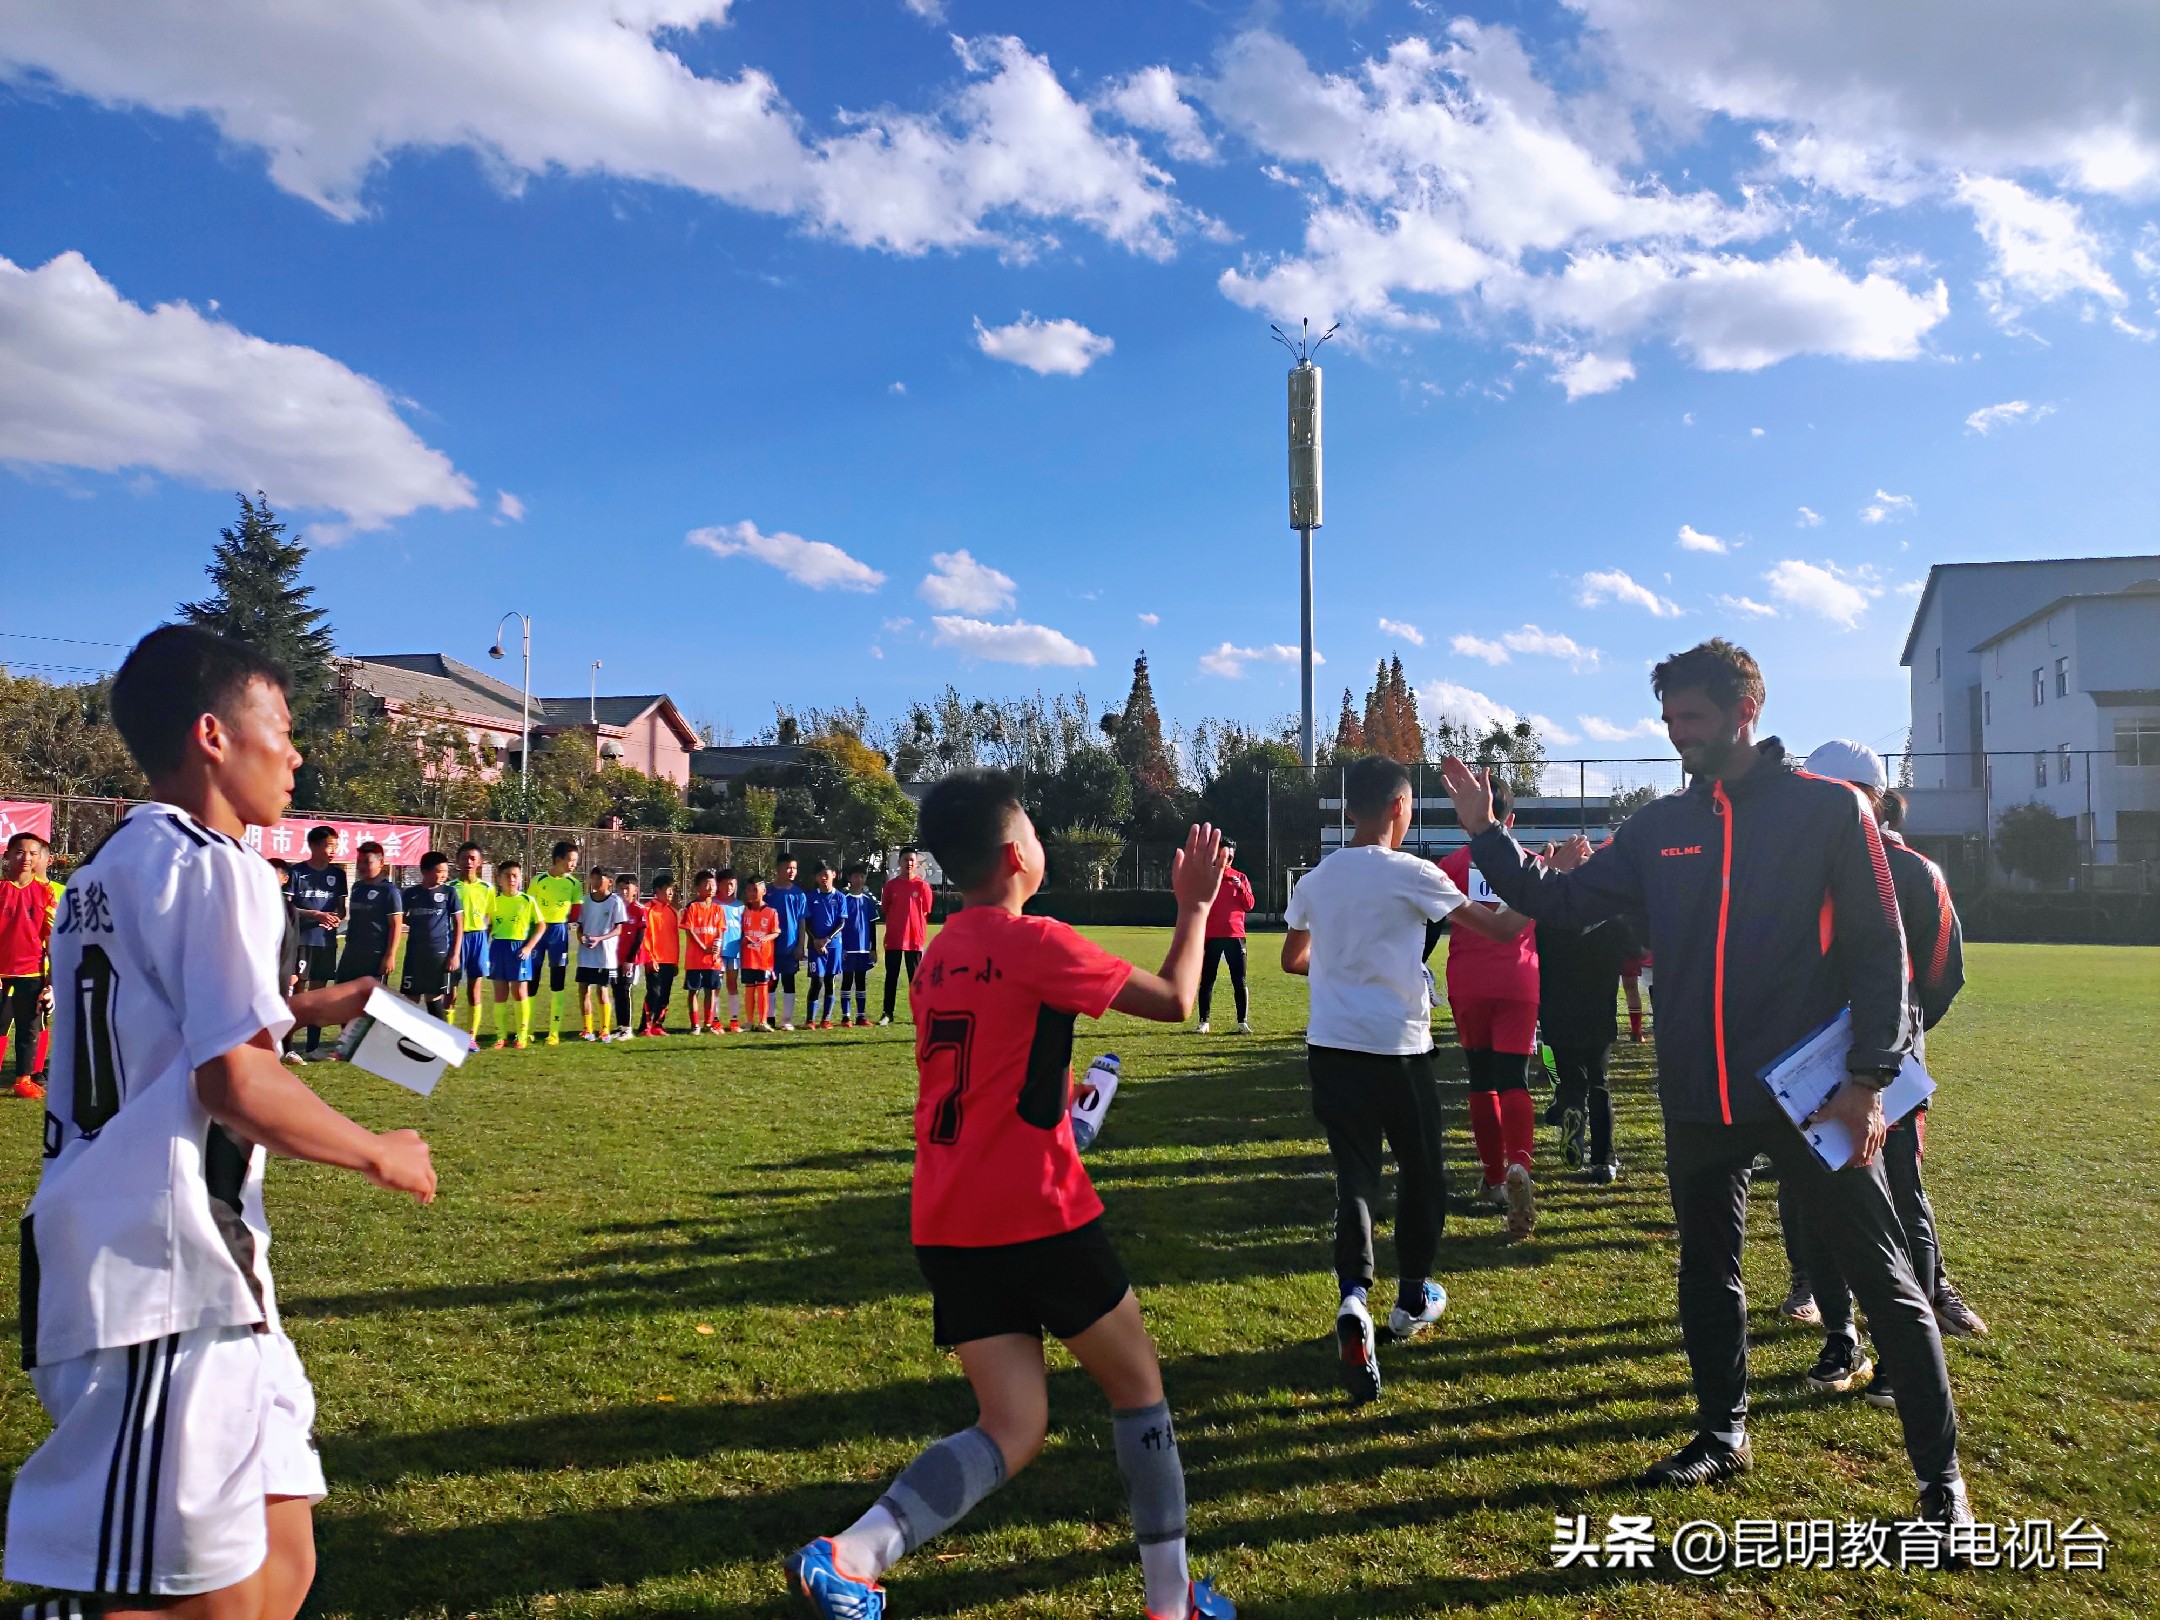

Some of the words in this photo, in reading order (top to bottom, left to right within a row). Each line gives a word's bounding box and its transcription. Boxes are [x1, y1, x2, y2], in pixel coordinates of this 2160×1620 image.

[1661, 845, 1702, 857] KELME
[403, 976, 412, 989] 5
[921, 1008, 975, 1145] 7
